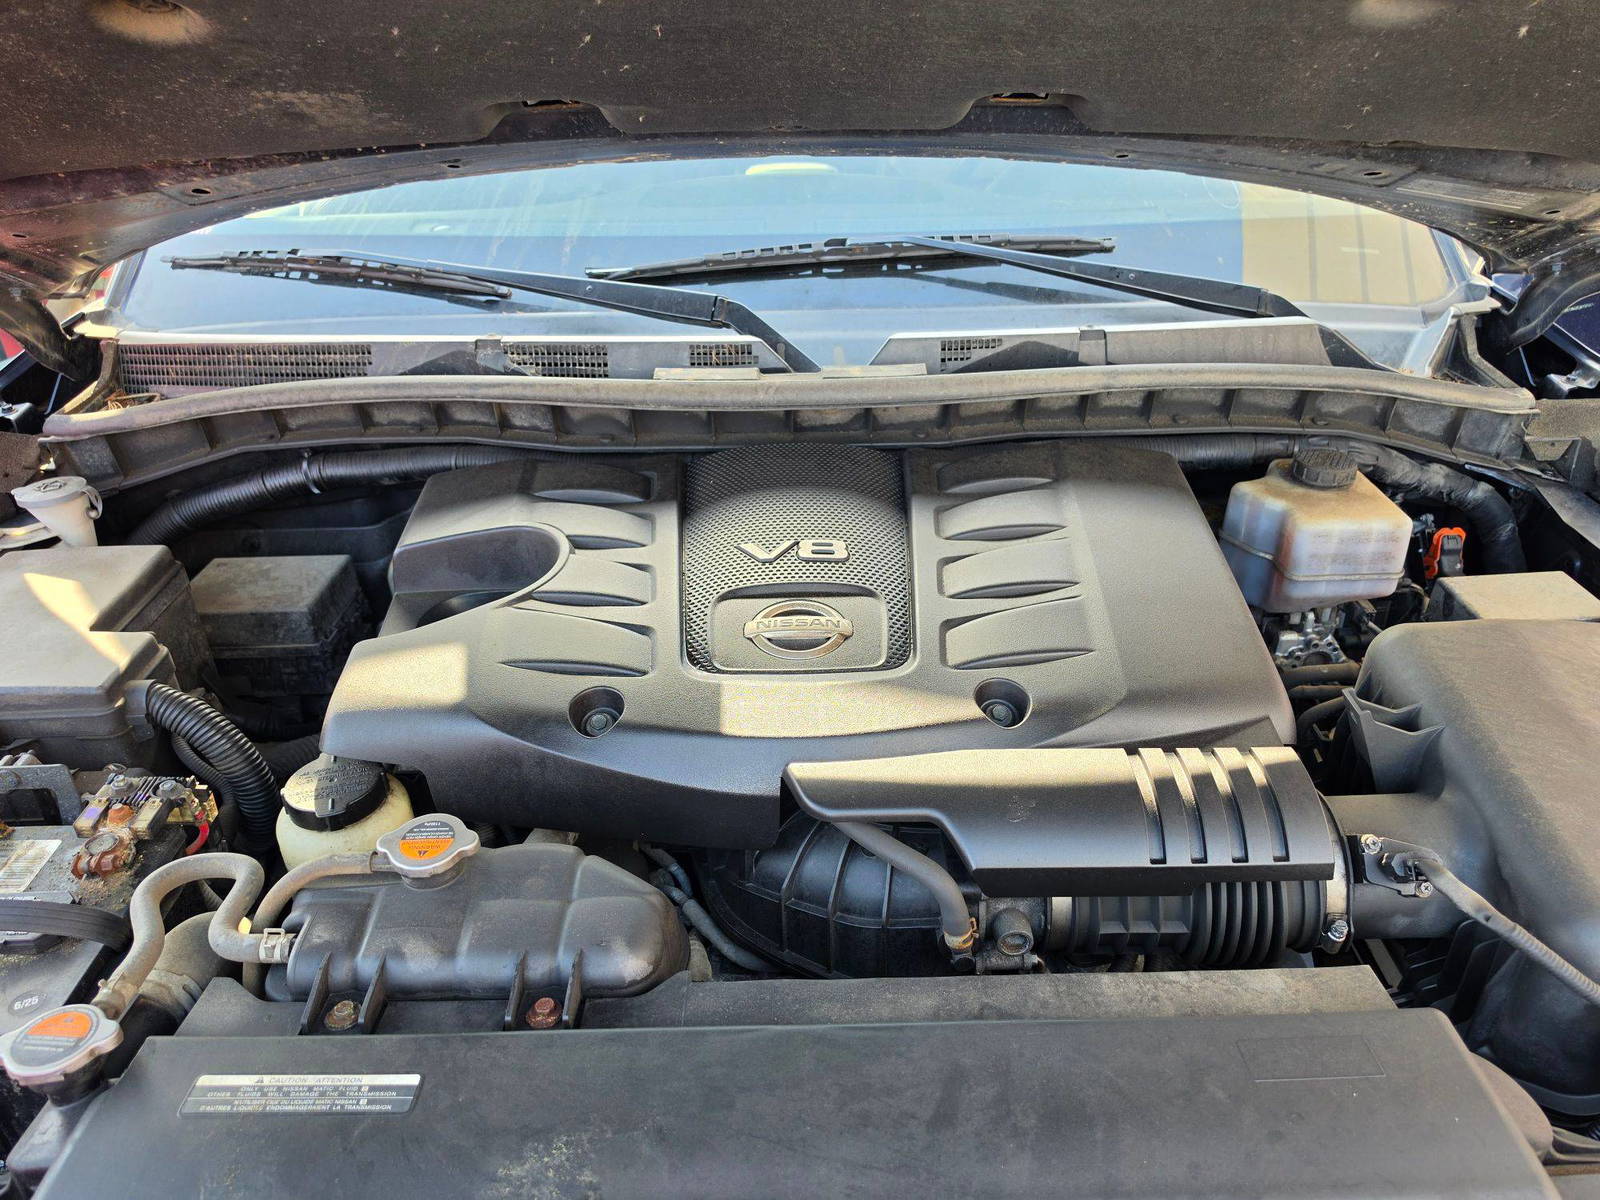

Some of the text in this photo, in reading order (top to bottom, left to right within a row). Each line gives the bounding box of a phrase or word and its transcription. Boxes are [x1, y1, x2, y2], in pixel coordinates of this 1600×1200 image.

[735, 539, 850, 562] V8
[756, 618, 841, 629] NISSAN
[14, 995, 39, 1011] 6/25
